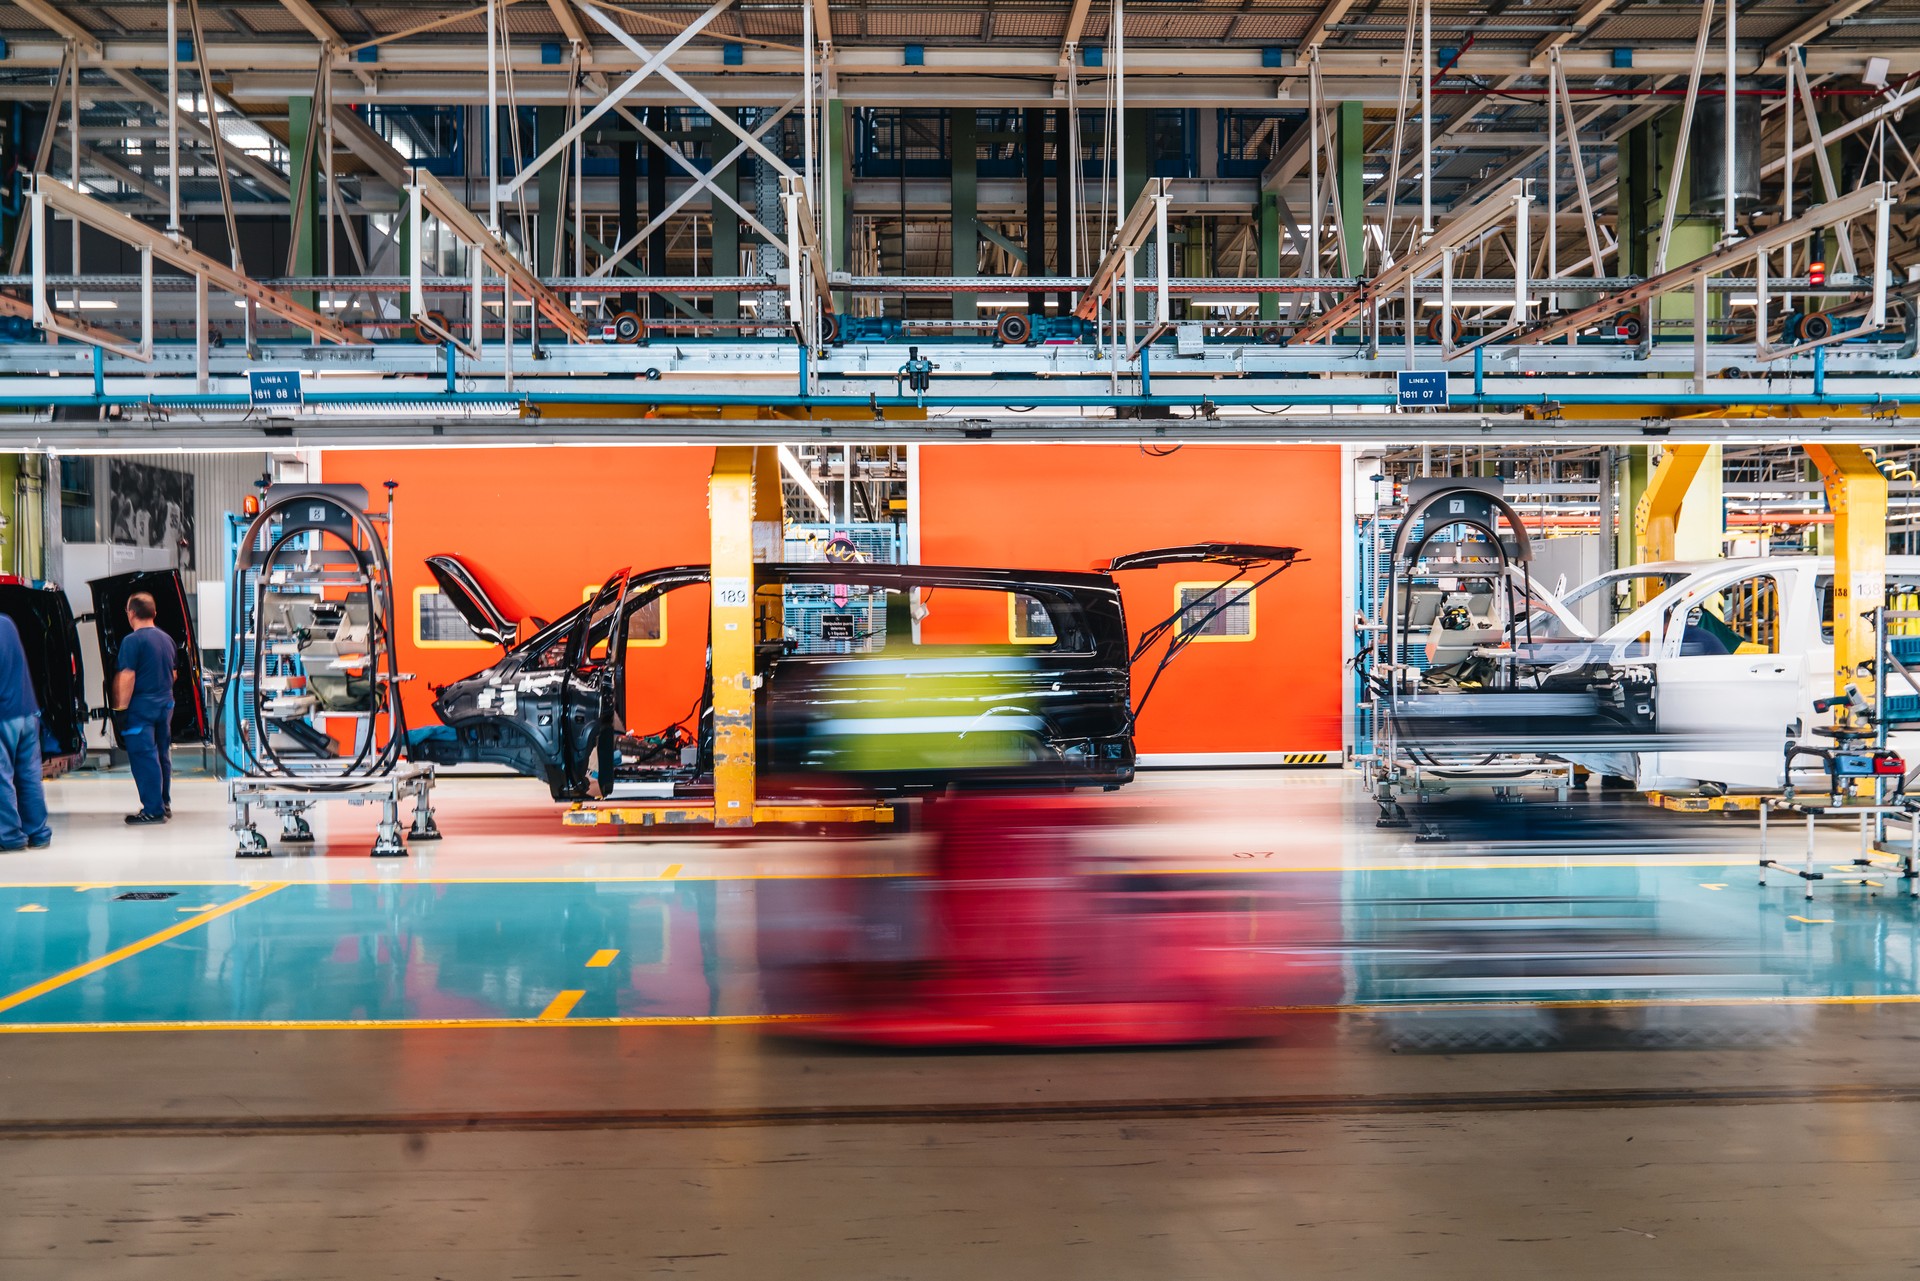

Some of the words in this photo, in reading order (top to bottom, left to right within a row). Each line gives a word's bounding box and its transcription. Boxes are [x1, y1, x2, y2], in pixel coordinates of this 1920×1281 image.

[1422, 390, 1434, 399] 07
[1453, 502, 1460, 512] 7
[313, 509, 321, 520] 8
[1834, 588, 1848, 597] 138
[1857, 583, 1881, 596] 138
[720, 590, 746, 603] 189
[1232, 851, 1275, 859] 07
